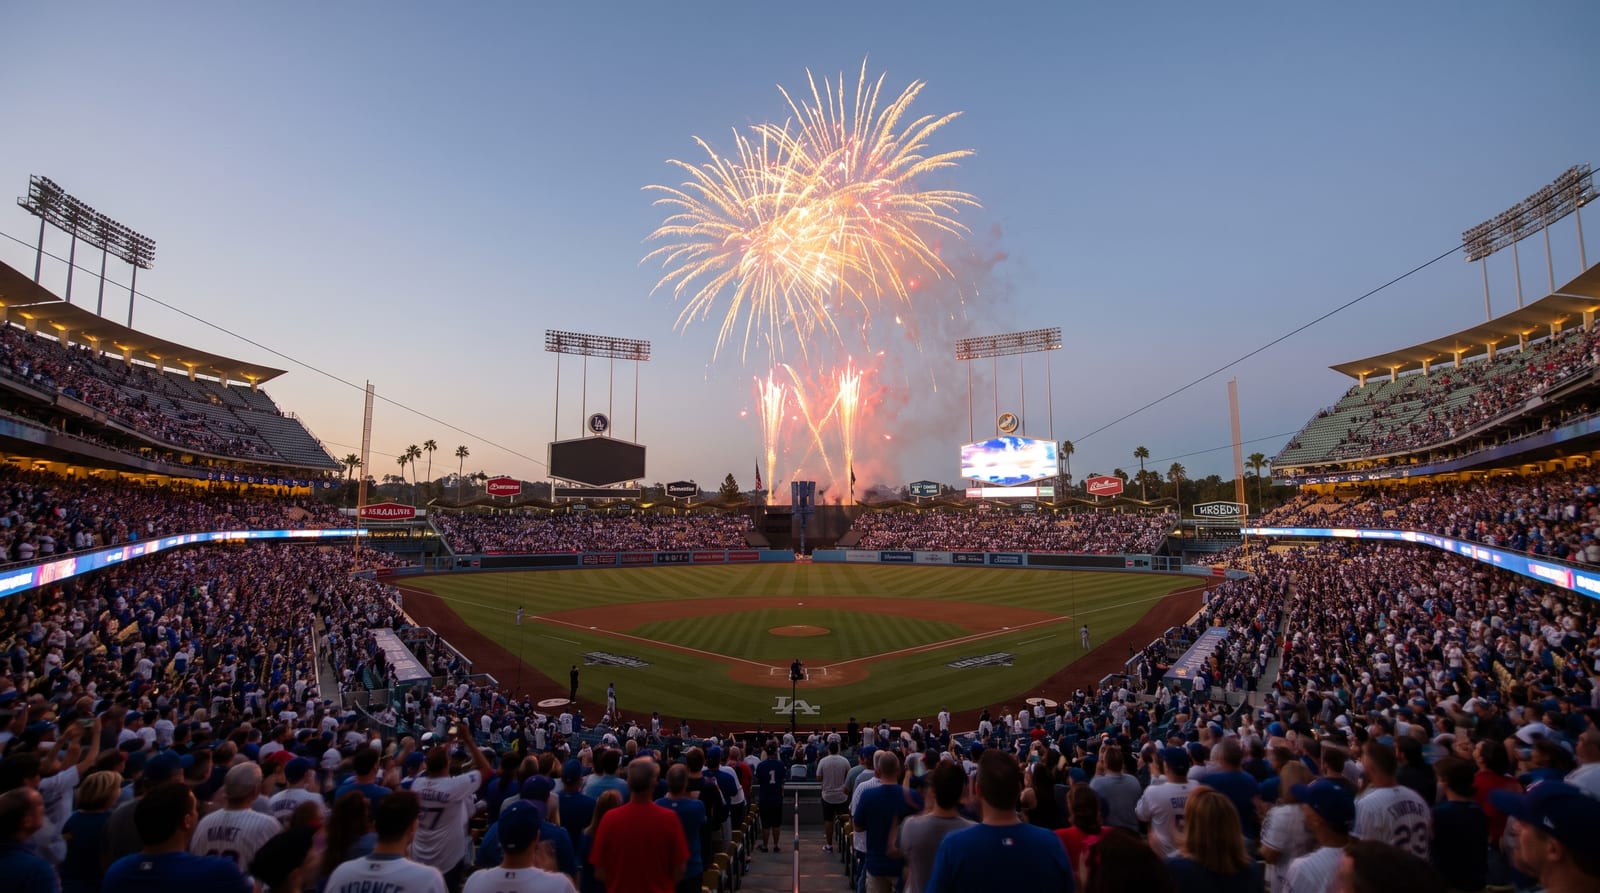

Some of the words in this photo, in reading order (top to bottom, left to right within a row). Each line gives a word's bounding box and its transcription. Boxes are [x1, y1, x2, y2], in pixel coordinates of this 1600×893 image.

[594, 416, 605, 430] LA
[771, 696, 820, 715] LA
[769, 769, 777, 785] 1
[1395, 822, 1427, 854] 23
